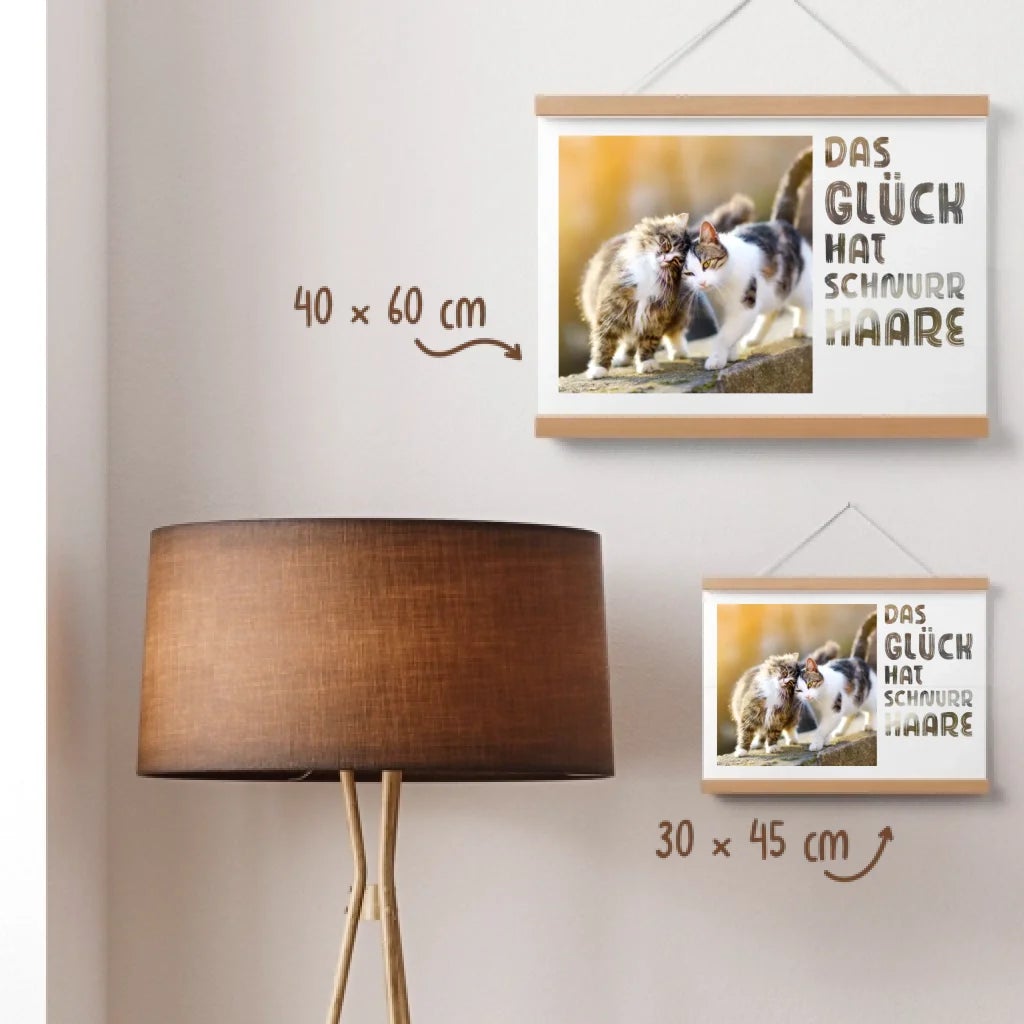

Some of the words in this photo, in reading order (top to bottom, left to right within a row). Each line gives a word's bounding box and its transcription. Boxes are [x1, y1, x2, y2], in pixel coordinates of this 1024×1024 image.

[825, 136, 890, 168] DAS
[825, 172, 965, 226] GLÜCK
[825, 233, 886, 264] HAT
[824, 272, 965, 300] SCHNURR
[826, 307, 965, 348] HAARE
[885, 604, 926, 624] DAS
[885, 627, 973, 661] GLÜCK
[884, 665, 923, 685] HAT
[884, 689, 973, 707] SCHNURR
[885, 712, 973, 737] HAARE
